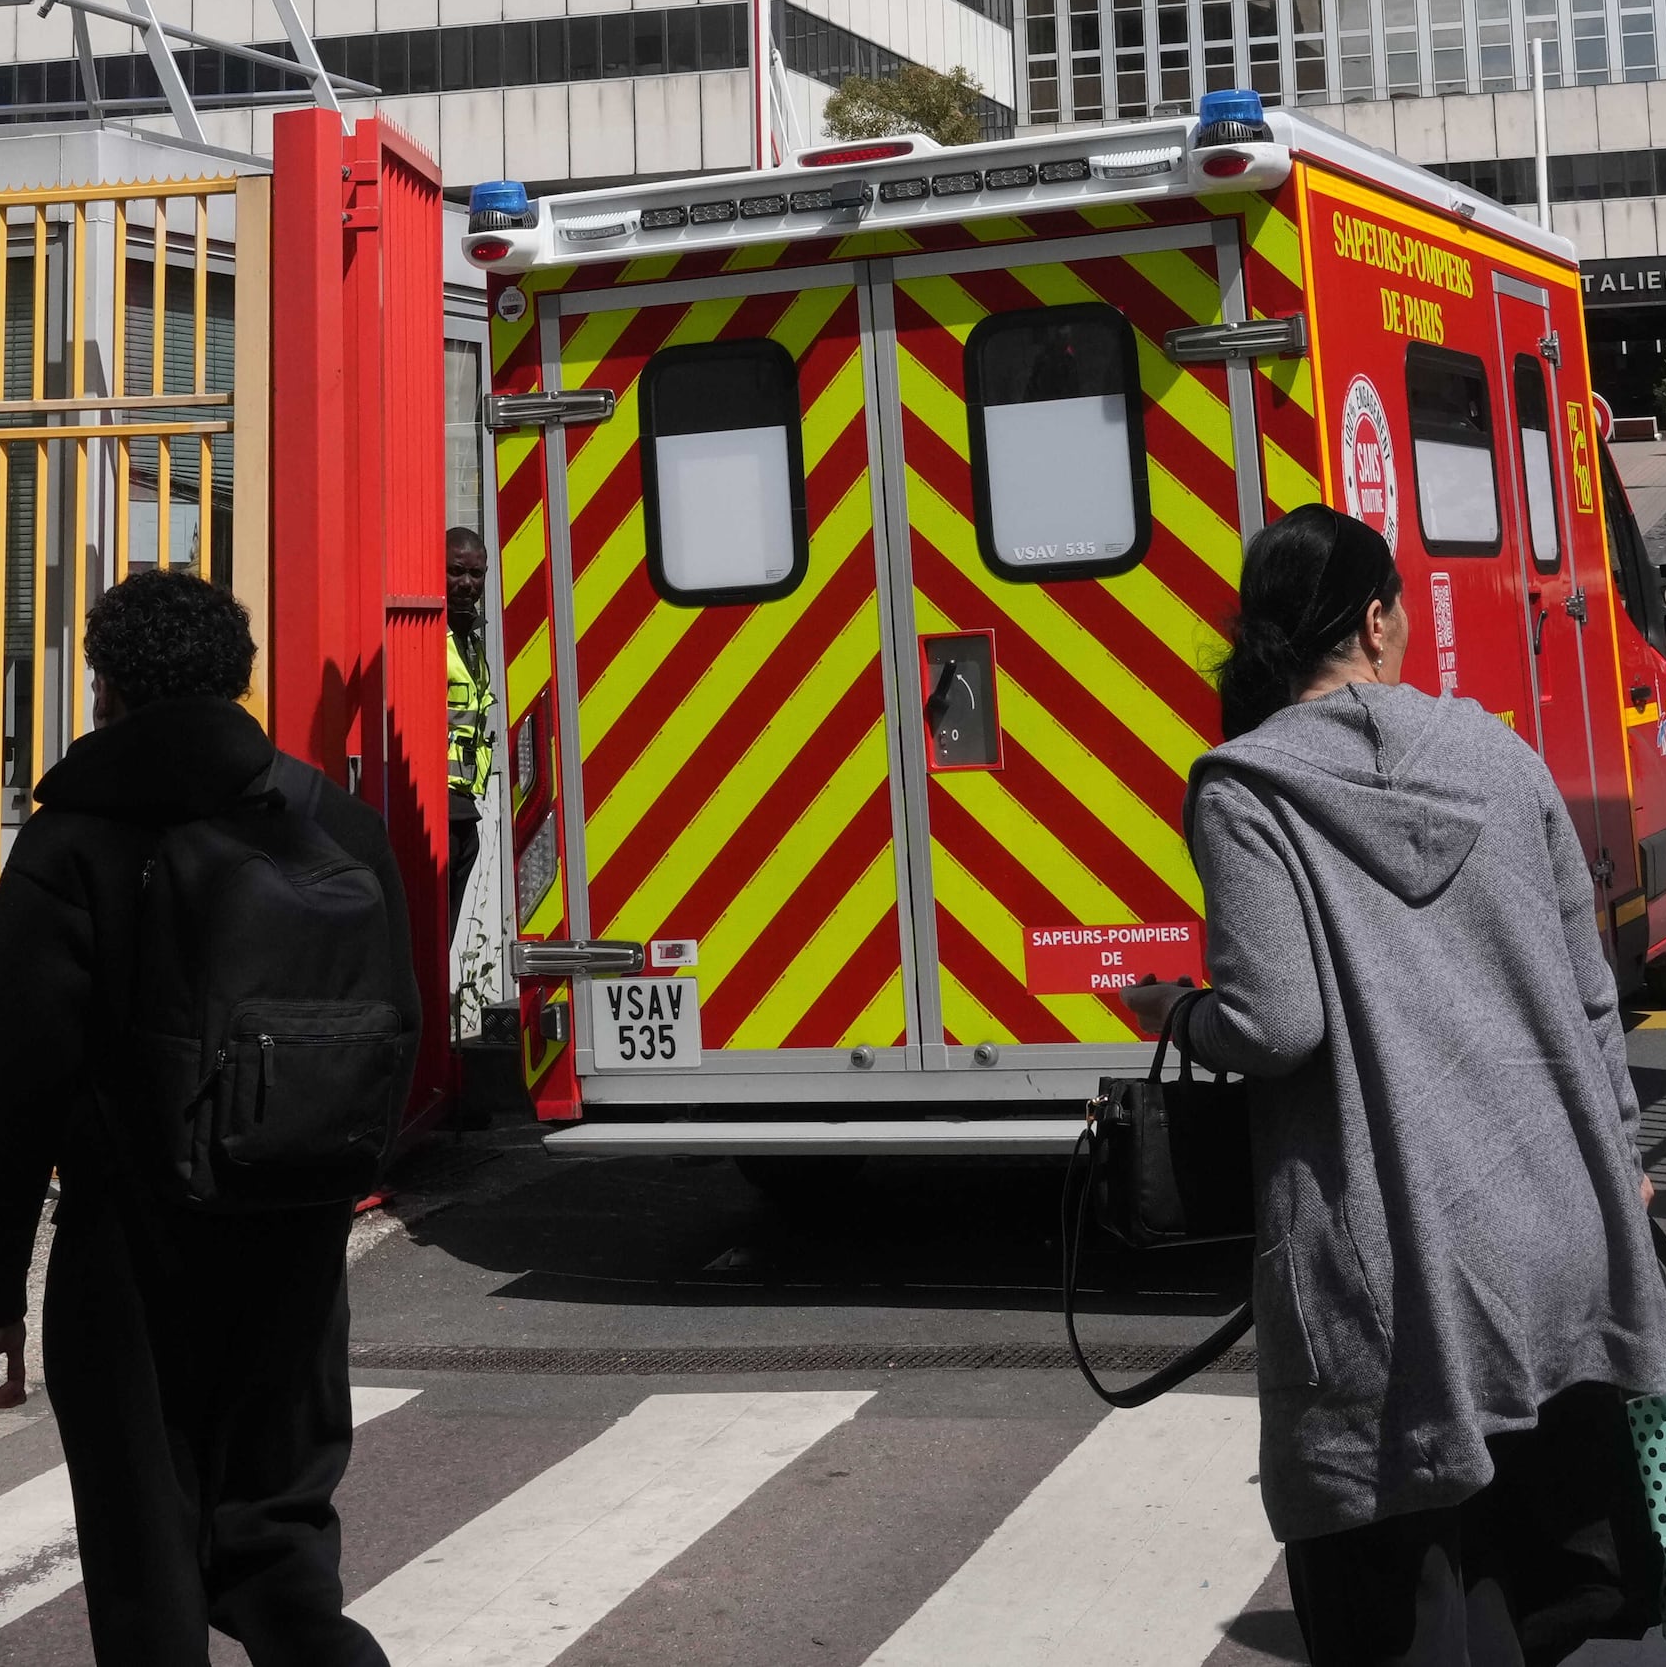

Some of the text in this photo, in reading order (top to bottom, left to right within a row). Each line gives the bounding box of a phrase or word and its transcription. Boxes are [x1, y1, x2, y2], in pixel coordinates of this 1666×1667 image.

[1332, 211, 1473, 299] SAPEURS-POMPIERS
[1380, 287, 1444, 345] DE PARIS
[1357, 442, 1381, 483] SANS
[1013, 544, 1058, 561] VSAV
[1065, 541, 1096, 556] 535
[1032, 927, 1190, 947] SAPEURS-POMPIERS
[1101, 951, 1123, 967] DE
[1091, 973, 1136, 988] PARIS
[606, 984, 683, 1021] VSAV
[618, 1024, 676, 1061] 535
